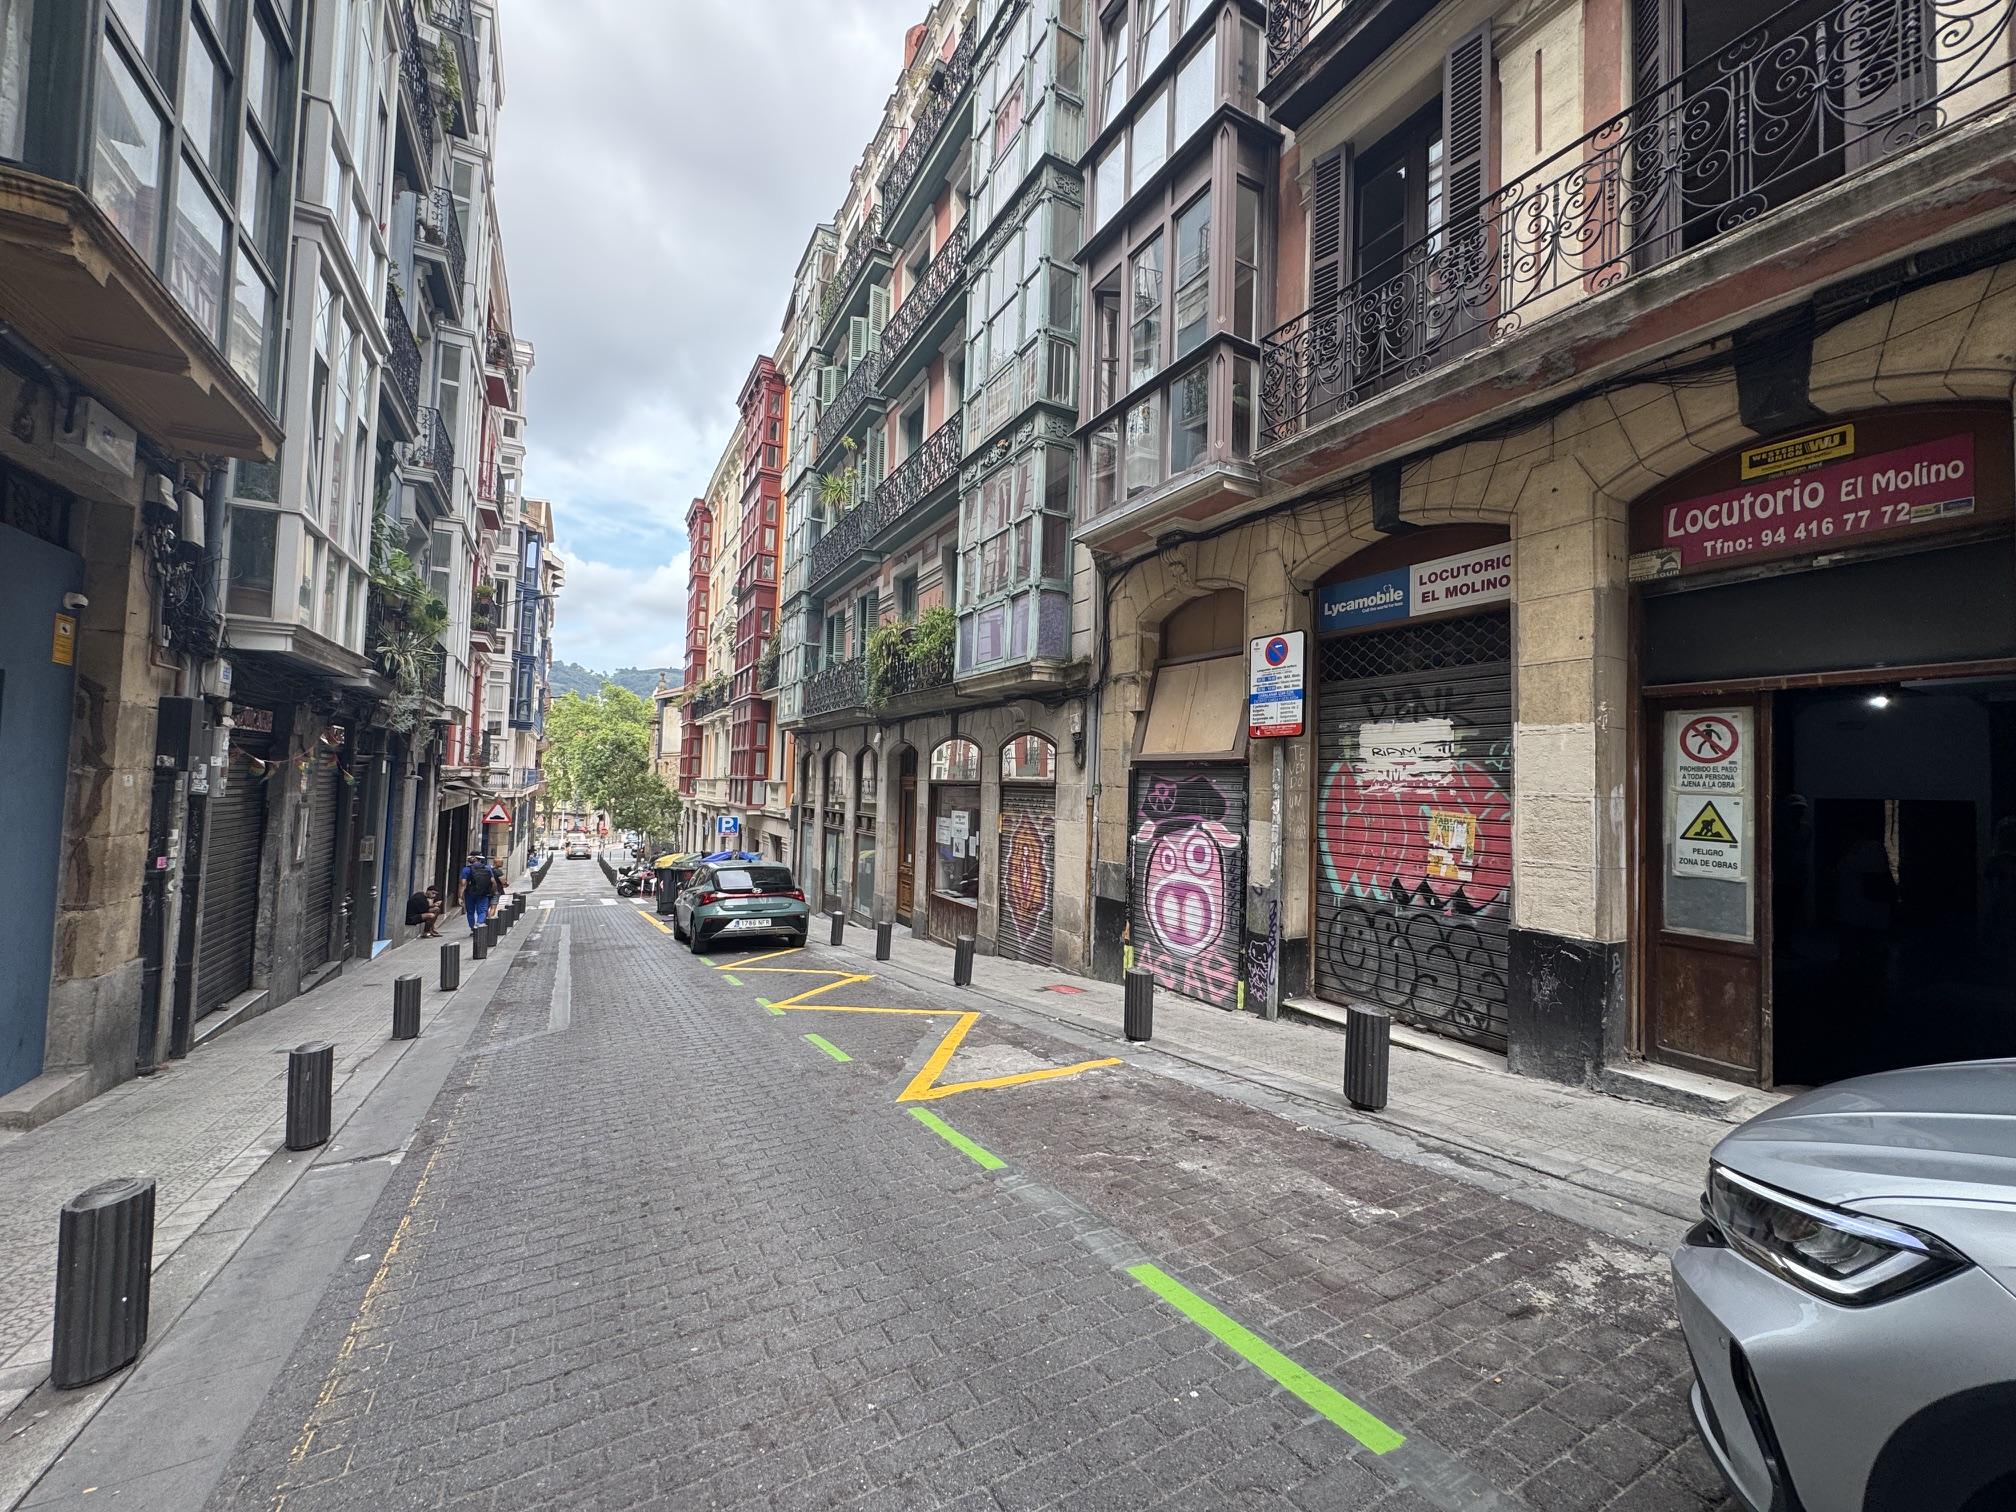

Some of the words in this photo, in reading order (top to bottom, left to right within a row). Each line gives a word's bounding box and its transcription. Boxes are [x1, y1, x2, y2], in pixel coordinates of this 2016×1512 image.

[1752, 444, 1803, 462] WESTERN
[1809, 434, 1841, 453] WU
[1767, 449, 1803, 463] UNION
[1667, 478, 1825, 538] Locutorio
[1840, 475, 1863, 502] El
[1872, 459, 1965, 496] Molino
[1703, 536, 1753, 557] Tfno:
[1761, 526, 1785, 547] 94
[1794, 517, 1834, 540] 416
[1843, 510, 1871, 531] 77
[1881, 502, 1910, 525] 72
[1419, 554, 1512, 586] LOCUTORIO
[1629, 569, 1681, 583] PROSEGUR
[1421, 590, 1440, 603] EL
[1444, 574, 1512, 599] MOLINO
[1324, 586, 1404, 617] Lycamobile
[1679, 765, 1711, 773] PROHIBIDO
[1704, 773, 1735, 781] PERSONA
[1681, 780, 1701, 788] AJENA
[1717, 781, 1736, 789] OBRA
[721, 817, 734, 832] P
[1692, 847, 1724, 857] PELIGRO
[1679, 857, 1699, 865] ZONA
[1700, 858, 1710, 867] DE
[1711, 860, 1738, 870] OBRAS
